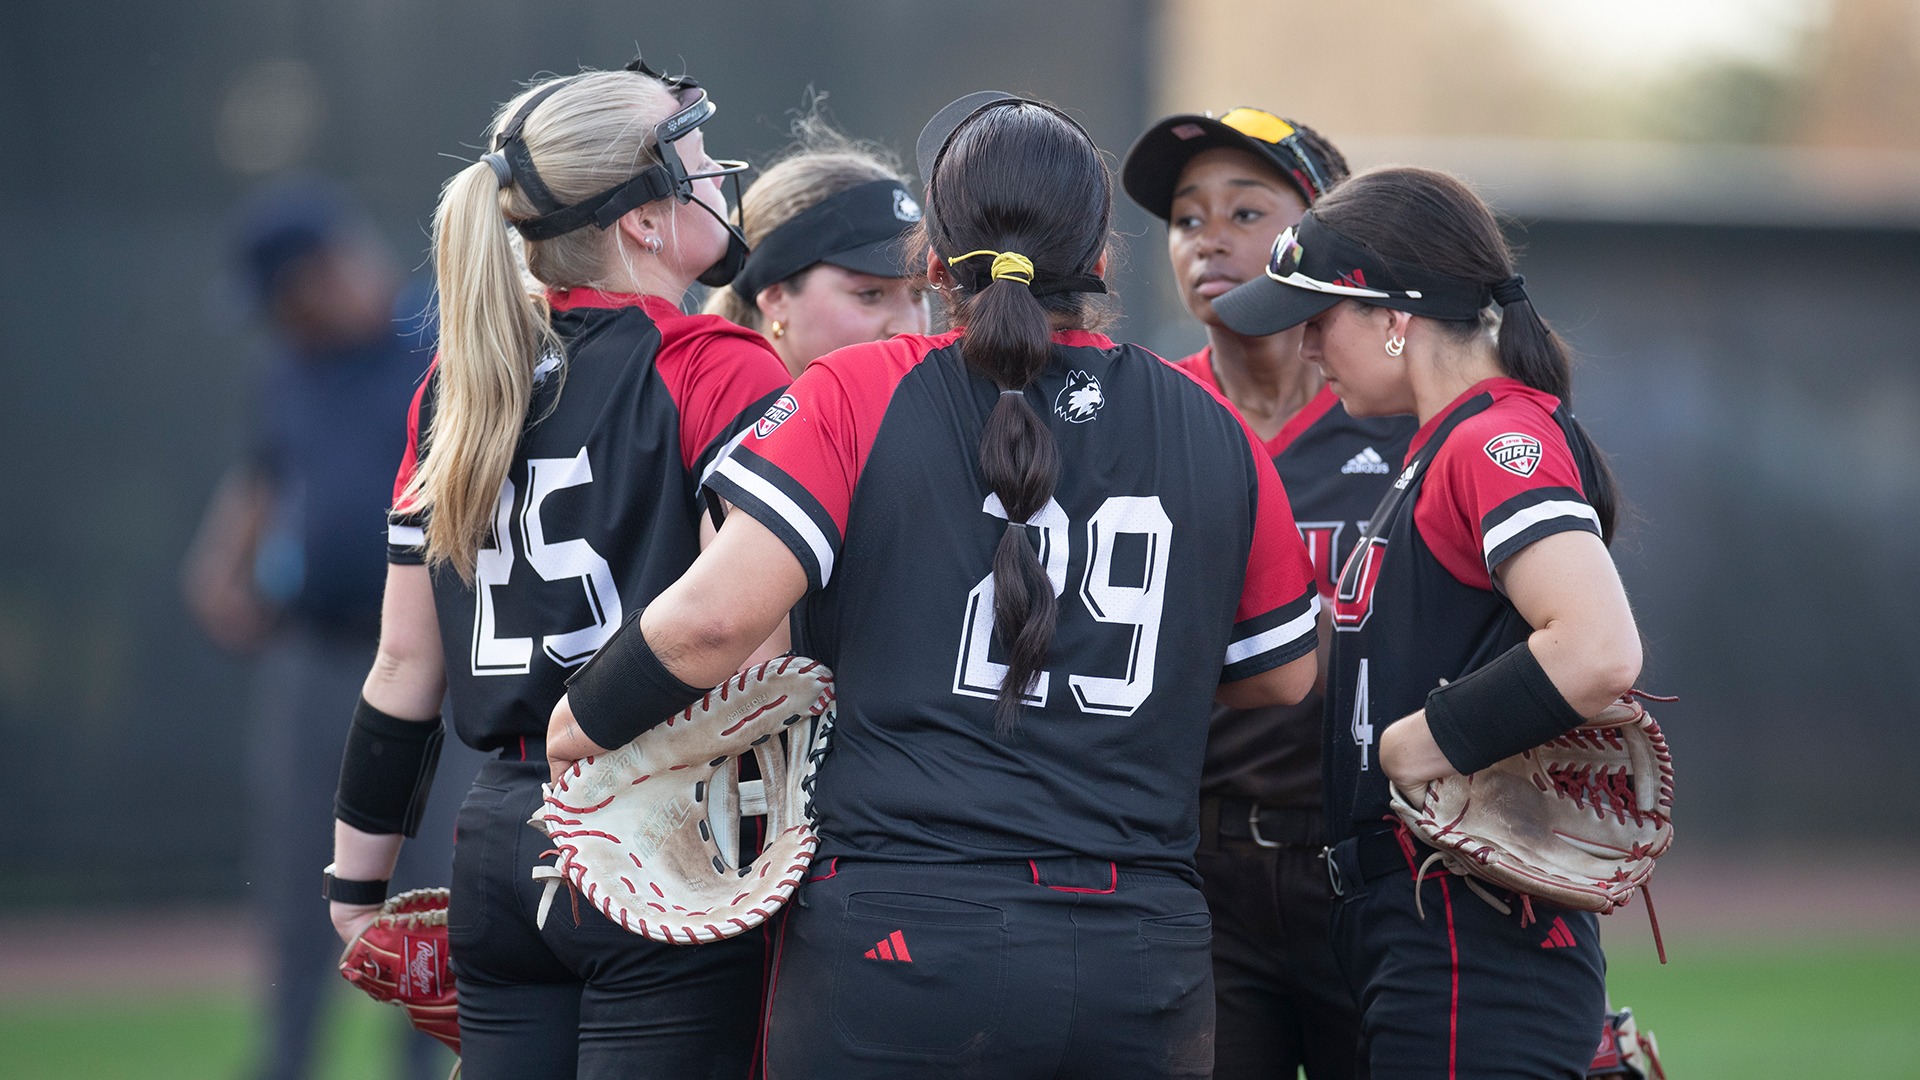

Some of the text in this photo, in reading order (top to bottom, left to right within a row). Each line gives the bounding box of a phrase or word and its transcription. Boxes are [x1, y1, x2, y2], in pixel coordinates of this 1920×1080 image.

[1341, 462, 1390, 474] adidas
[1494, 445, 1540, 464] MAC
[471, 445, 622, 677] 25
[952, 491, 1174, 717] 29
[1350, 658, 1373, 771] 4
[411, 940, 434, 995] Rawlings
